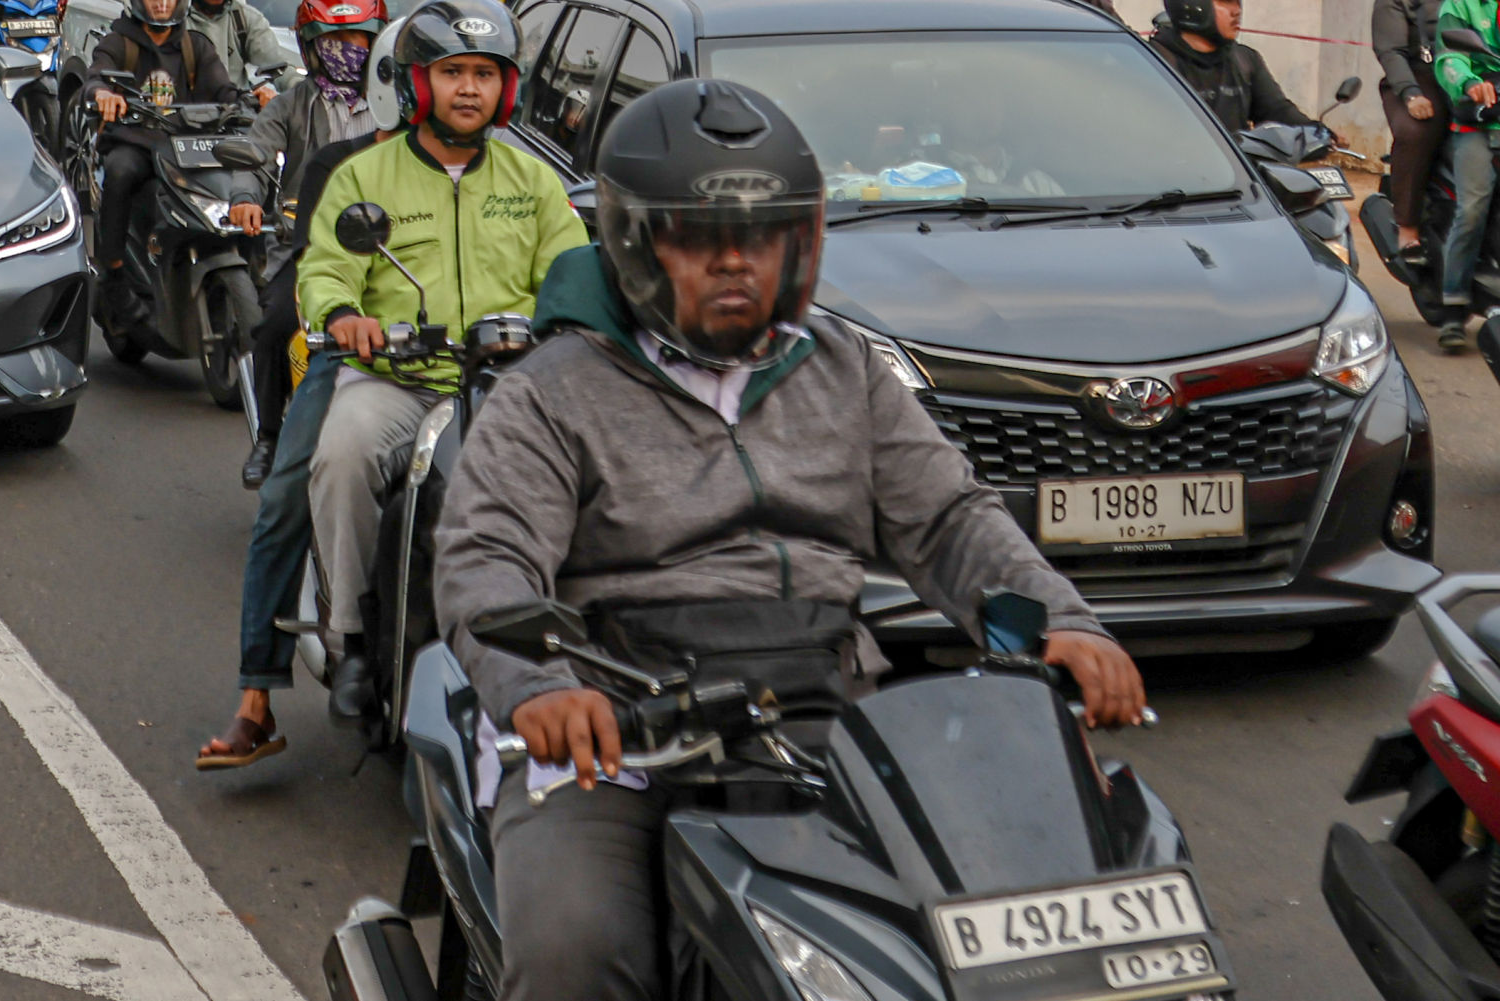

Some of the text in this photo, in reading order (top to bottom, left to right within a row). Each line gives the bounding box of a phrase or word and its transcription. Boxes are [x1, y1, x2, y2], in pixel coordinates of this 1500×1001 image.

[177, 139, 219, 152] B 405
[706, 177, 777, 192] INK
[1051, 481, 1234, 524] B 1988 NZU
[1113, 543, 1173, 553] ASTRIDO TOYOTA
[954, 884, 1187, 958] B 4924 SYT
[987, 964, 1058, 985] HONDA
